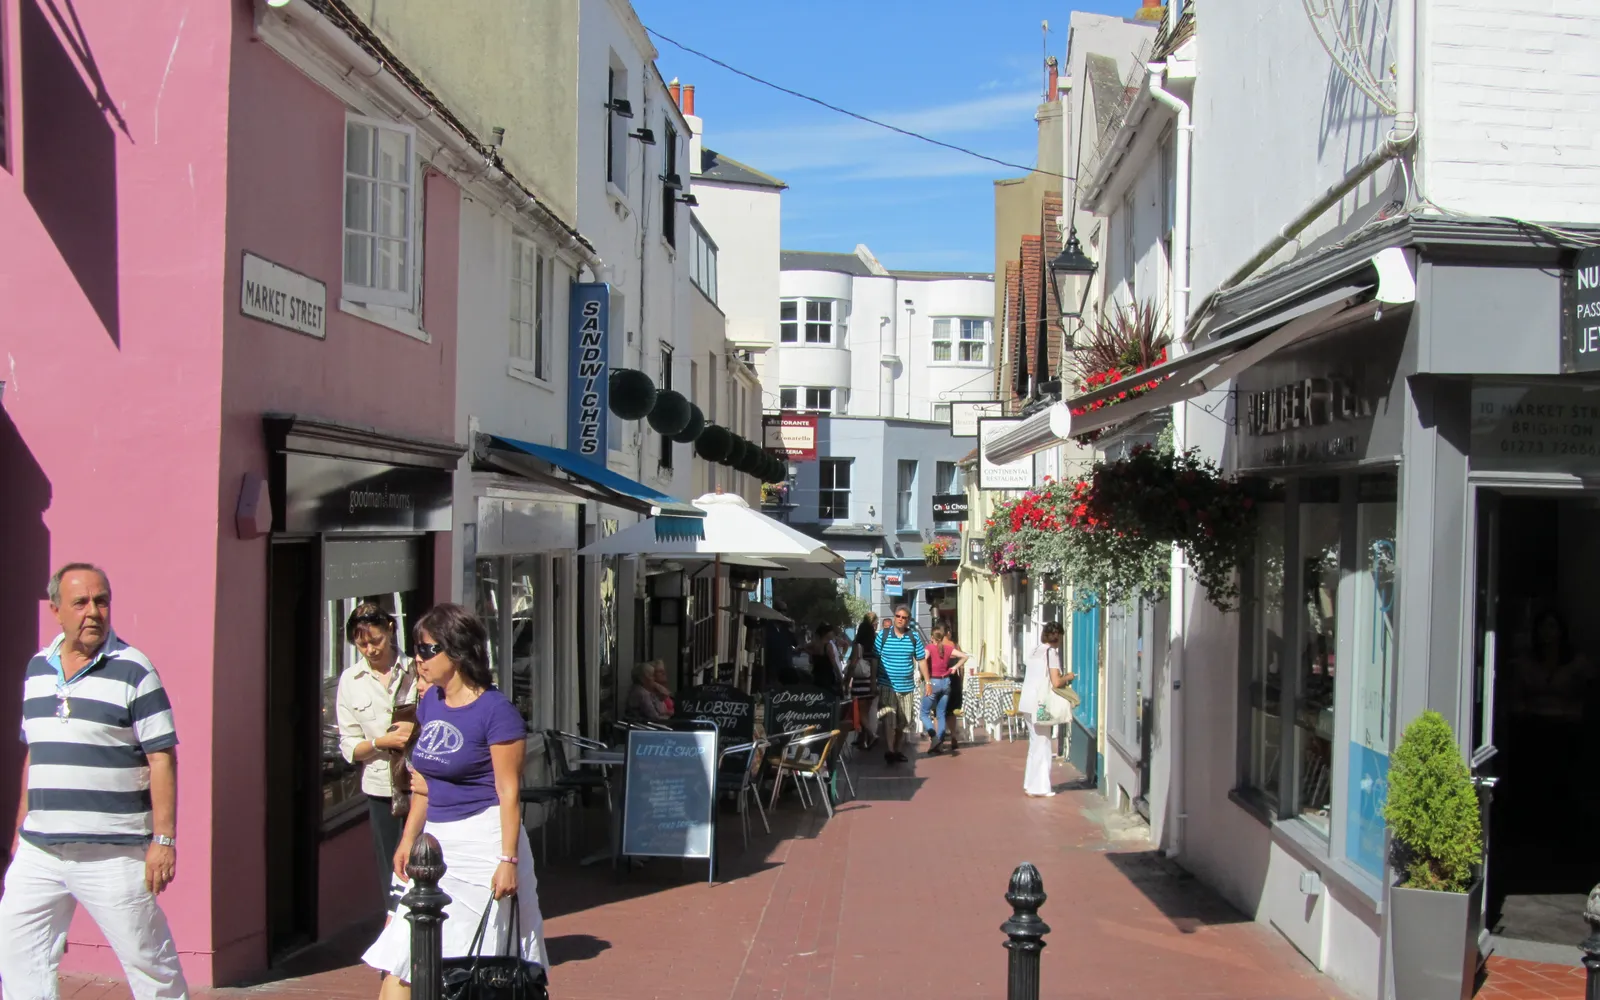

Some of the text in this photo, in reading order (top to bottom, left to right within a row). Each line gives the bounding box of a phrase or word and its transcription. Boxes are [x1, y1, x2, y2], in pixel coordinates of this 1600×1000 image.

[1577, 265, 1600, 290] NU
[246, 280, 323, 329] MARKET STREET
[1579, 327, 1600, 353] JE
[579, 300, 605, 454] SANDWICHES
[1248, 378, 1313, 436] NUMBER
[1480, 402, 1600, 419] 10 MARKET STR
[1512, 421, 1593, 437] BRIGHTON
[1500, 438, 1544, 454] 01273
[772, 690, 825, 707] Darcys
[696, 700, 749, 716] LOBSTER
[776, 710, 830, 722] Afternoon
[636, 744, 706, 758] LITTLE SHOP
